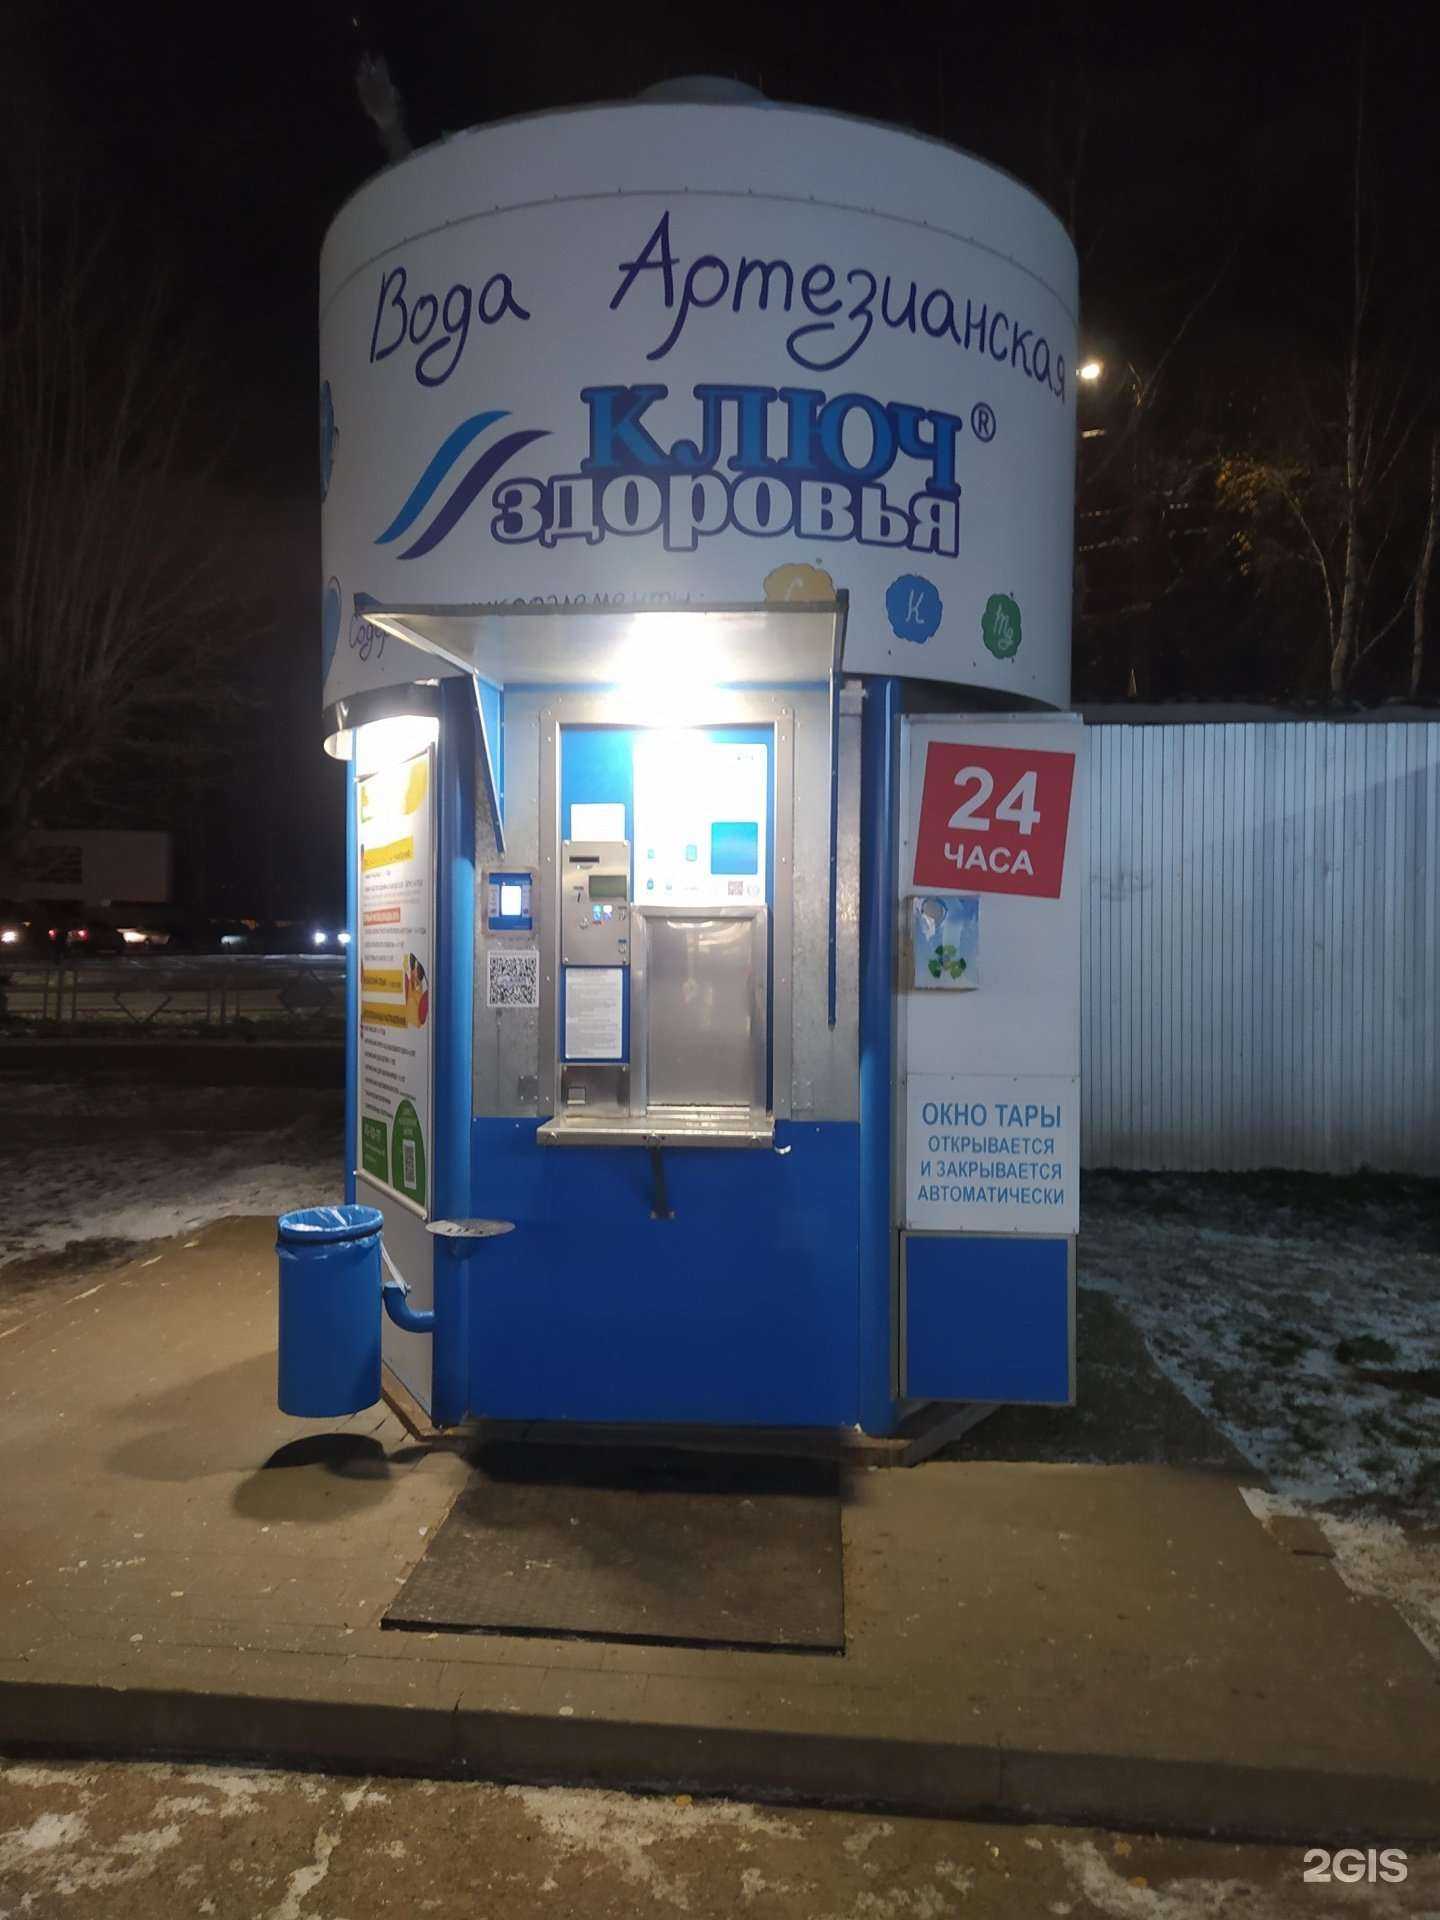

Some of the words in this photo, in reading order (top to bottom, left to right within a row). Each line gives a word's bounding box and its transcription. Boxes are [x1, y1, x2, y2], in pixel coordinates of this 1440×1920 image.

[370, 266, 531, 388] Вода
[609, 210, 1067, 405] Артезианская
[579, 383, 963, 498] КЛЮЧ
[947, 765, 1041, 836] 24
[943, 842, 1034, 876] ЧАСА
[922, 1101, 988, 1127] ОКНО
[994, 1103, 1062, 1129] ТАРЫ
[928, 1134, 1055, 1155] ОТКРЫВАЕТСЯ
[920, 1160, 932, 1177] И
[936, 1160, 1062, 1180] ЗАКРЫВАЕТСЯ
[917, 1184, 1065, 1206] АВТОМАТИЧЕСКИ
